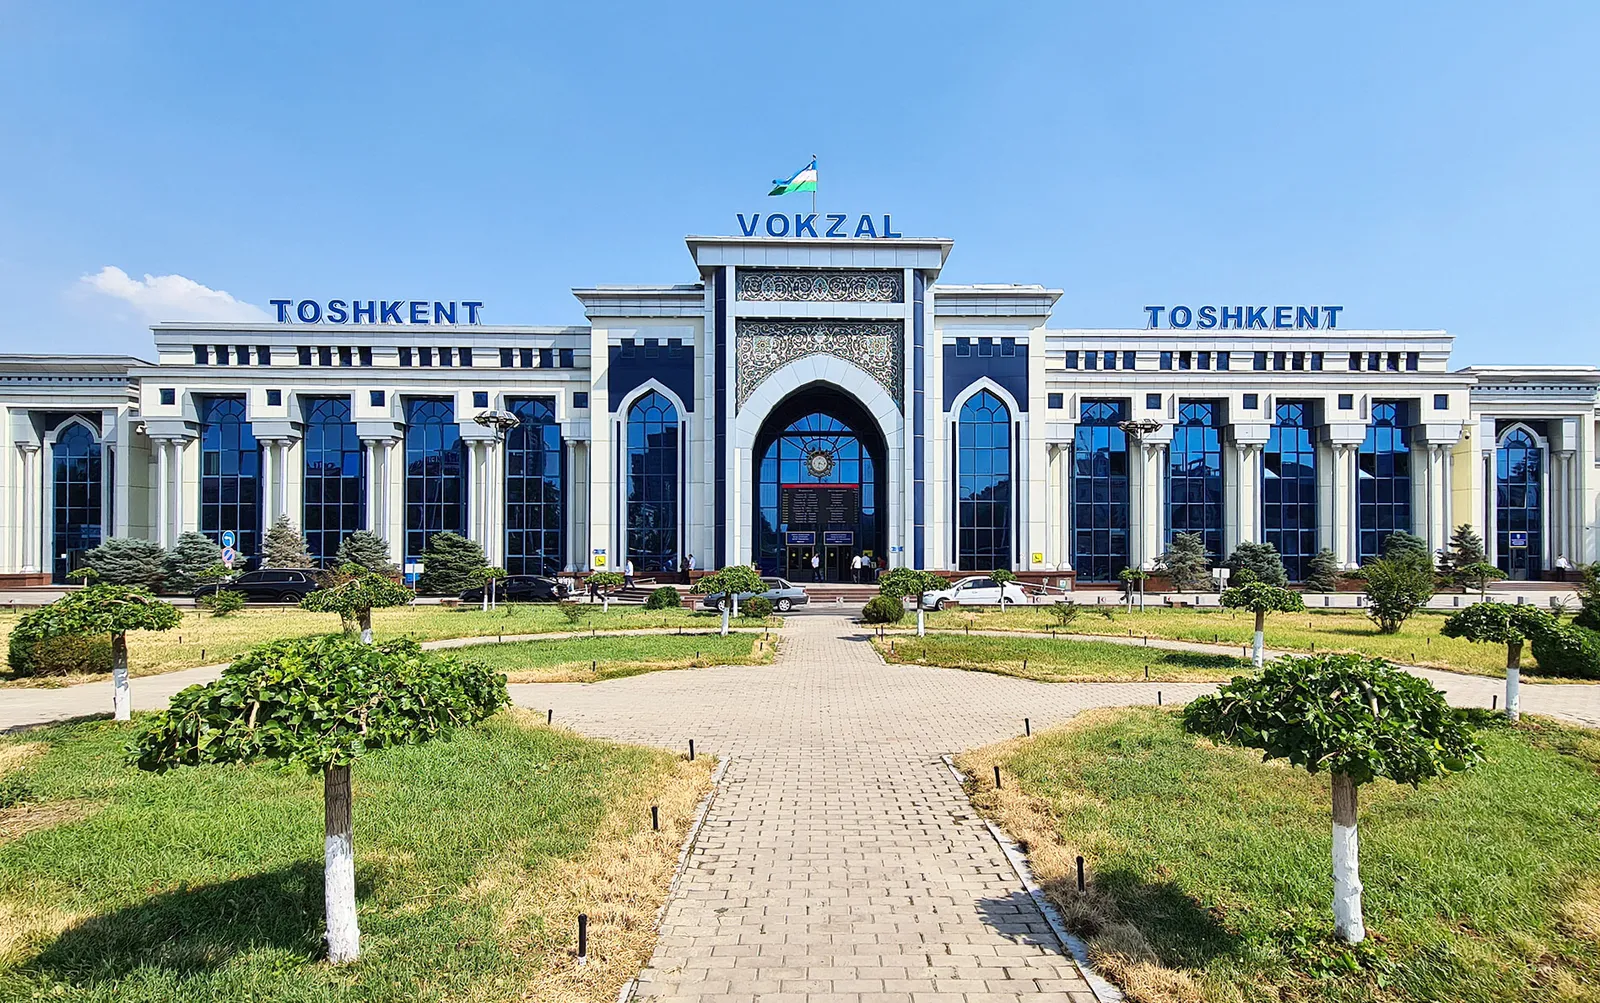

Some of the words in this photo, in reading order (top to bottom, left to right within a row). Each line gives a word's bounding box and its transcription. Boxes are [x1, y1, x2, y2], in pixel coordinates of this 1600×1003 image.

[736, 213, 902, 238] VOKZAL
[270, 300, 483, 324] TOSHKENT
[1144, 306, 1344, 328] TOSHKENT
